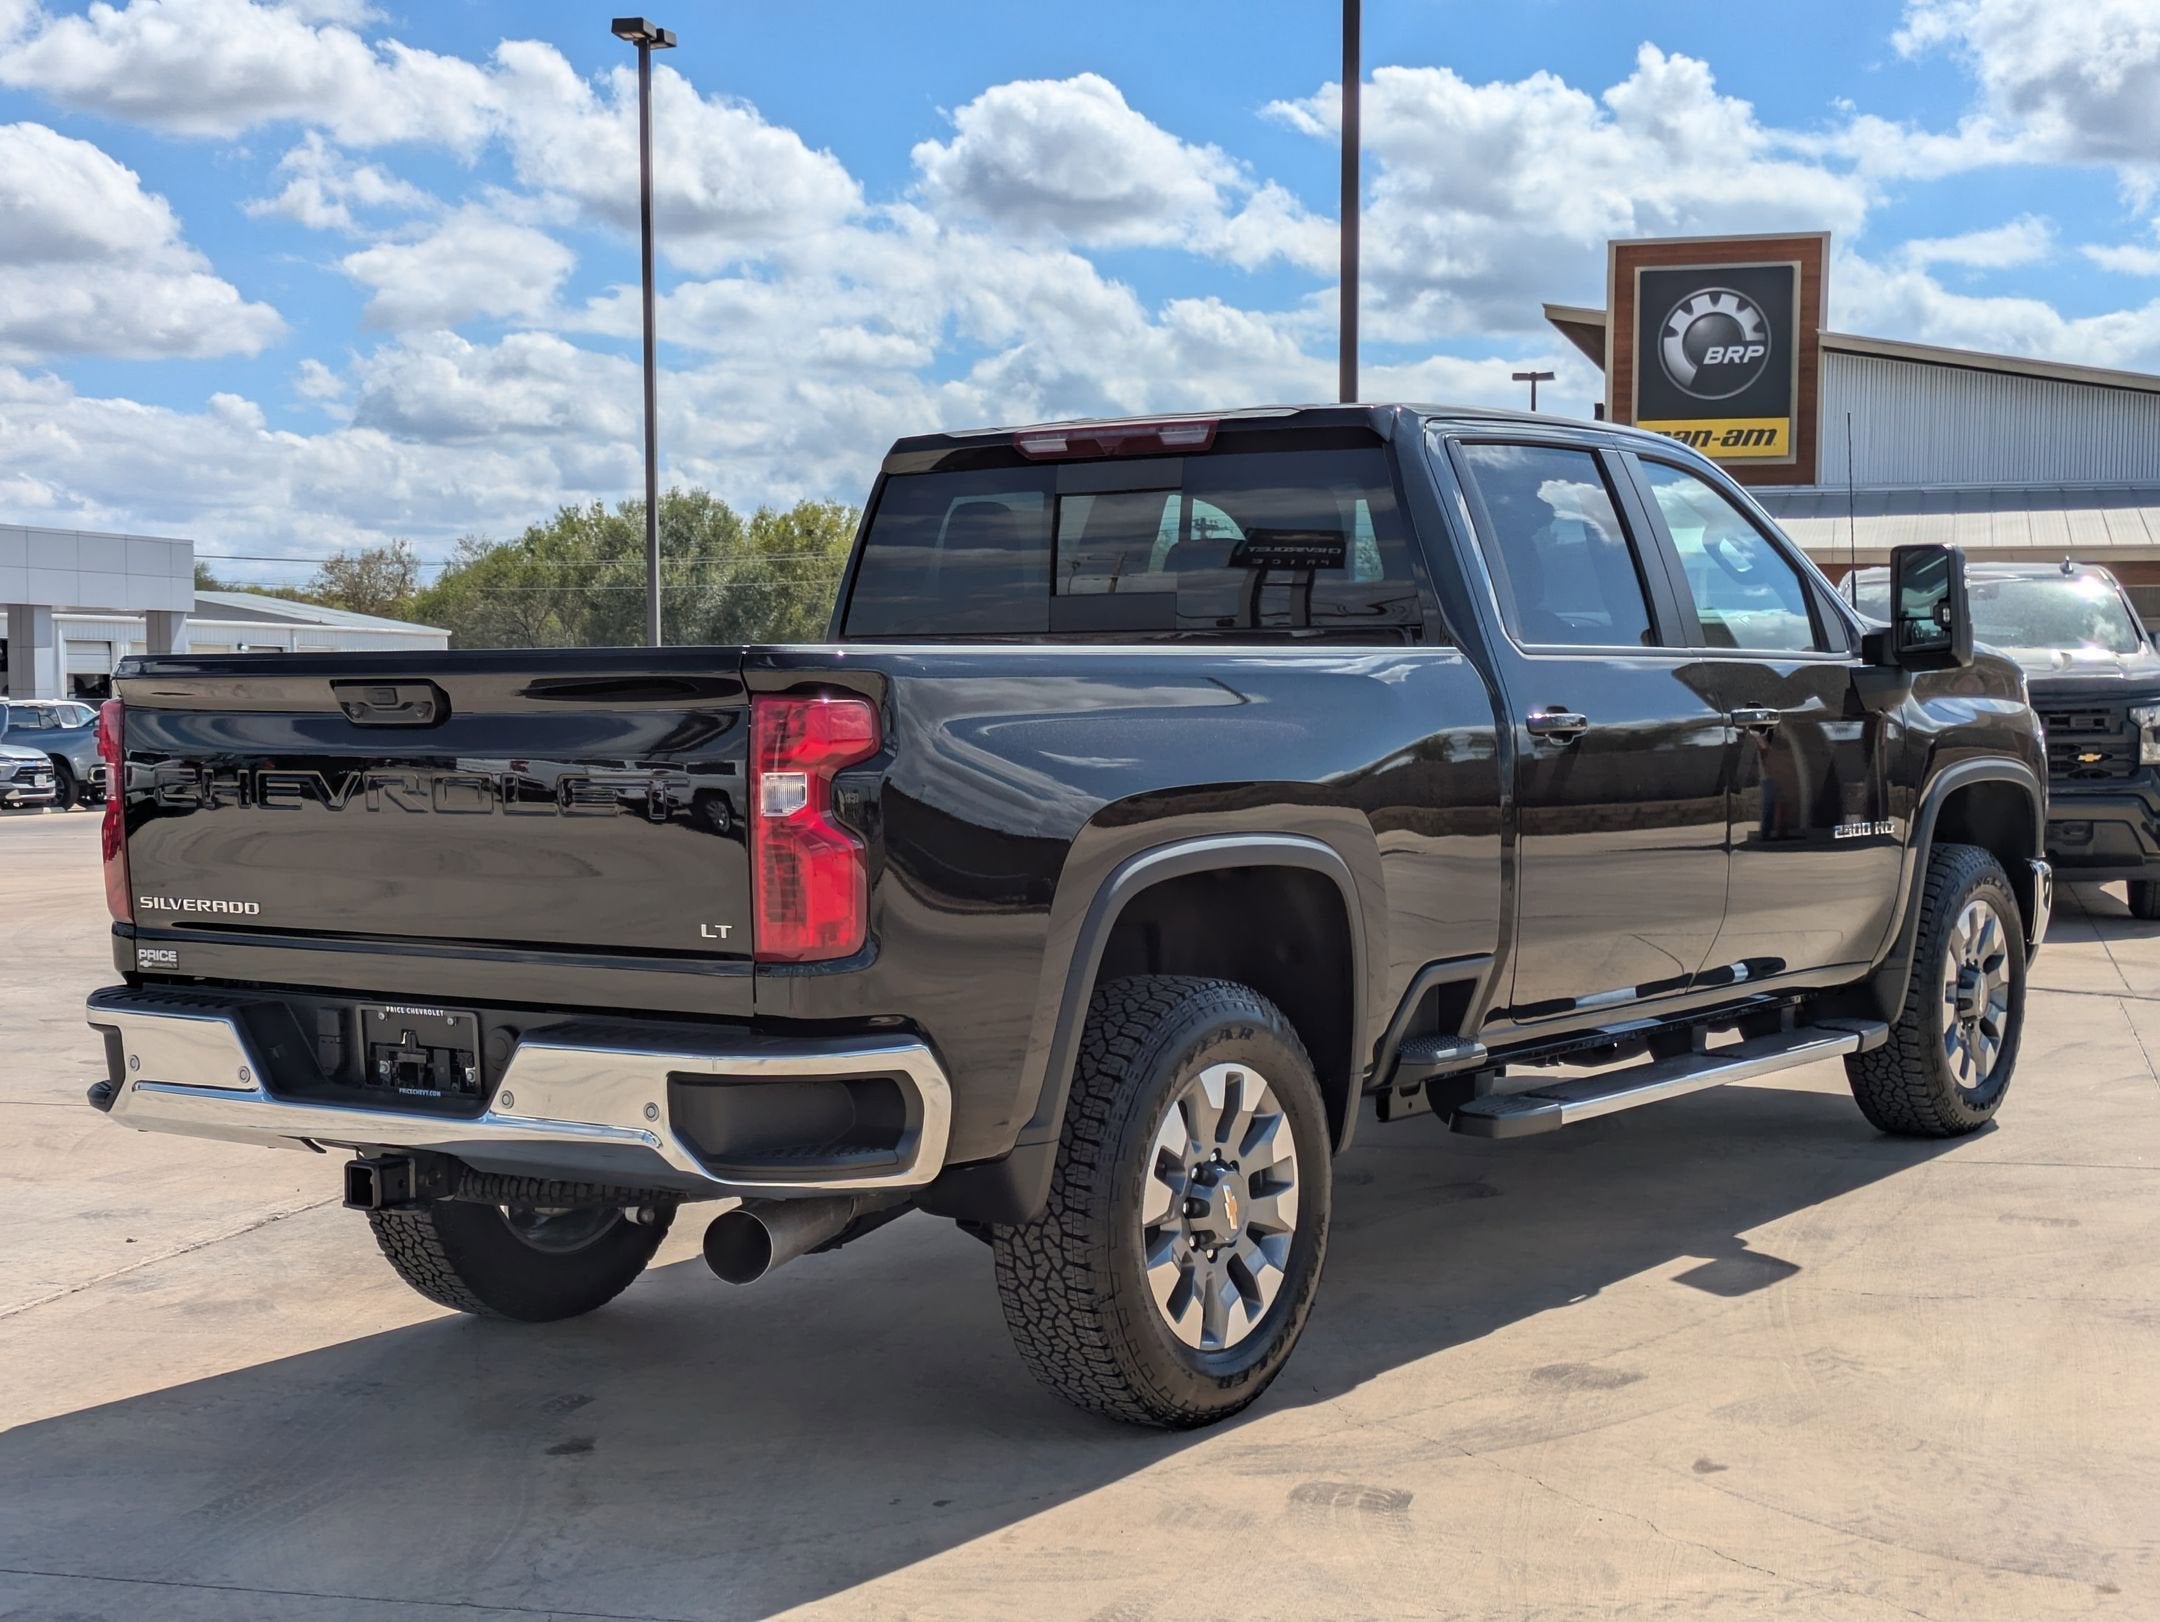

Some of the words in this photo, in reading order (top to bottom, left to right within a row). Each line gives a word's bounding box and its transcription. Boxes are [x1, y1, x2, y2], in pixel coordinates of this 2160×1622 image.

[1703, 345, 1765, 365] BRP
[154, 768, 691, 821] CHEVROLET
[1834, 822, 1872, 839] 2500
[1874, 821, 1895, 835] HD
[140, 896, 260, 915] SILVERADO
[701, 923, 733, 939] LT
[138, 949, 178, 962] PRICE
[385, 1006, 405, 1014] PRICE
[406, 1007, 444, 1017] CHEVROLET
